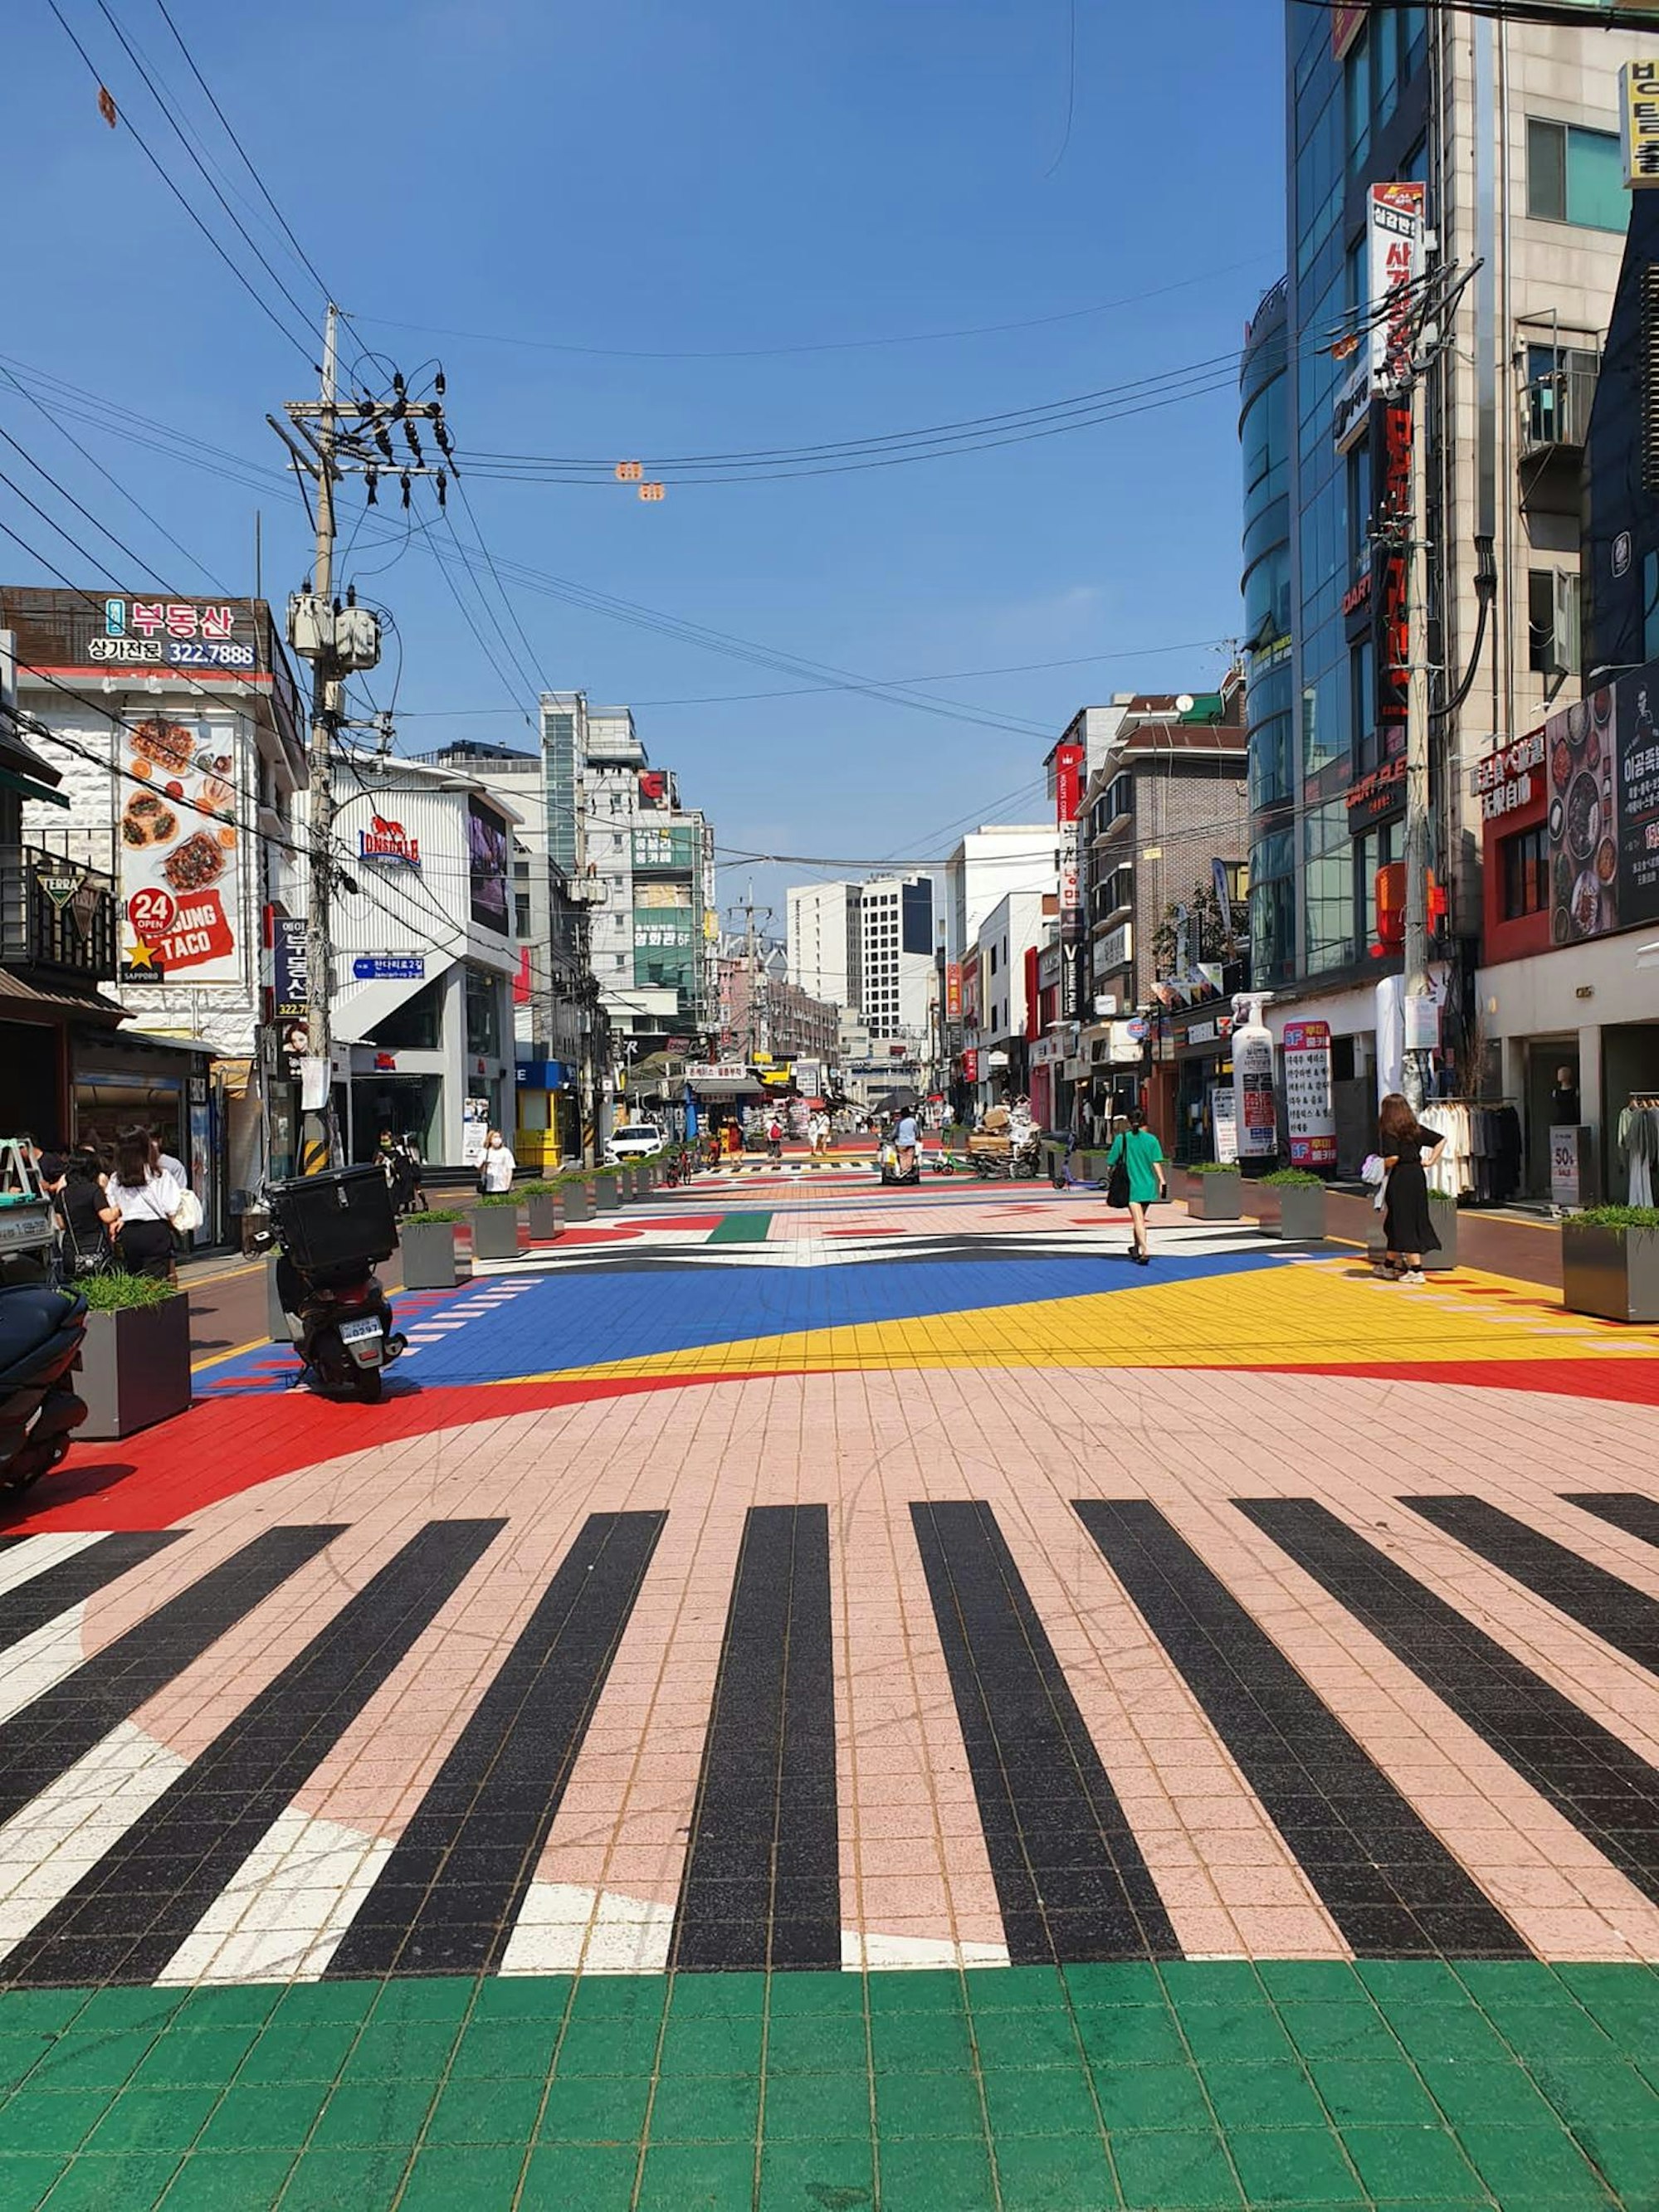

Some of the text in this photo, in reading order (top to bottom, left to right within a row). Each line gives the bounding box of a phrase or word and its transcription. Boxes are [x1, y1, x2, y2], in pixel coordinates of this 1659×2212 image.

[132, 602, 234, 639] 부동산
[90, 640, 162, 661] 상가전문
[42, 878, 79, 892] TERRA
[134, 894, 168, 919] 24
[138, 920, 163, 929] OPEN
[160, 930, 212, 960] TACO
[634, 932, 676, 947] 영화관
[124, 972, 159, 980] SAPPORO
